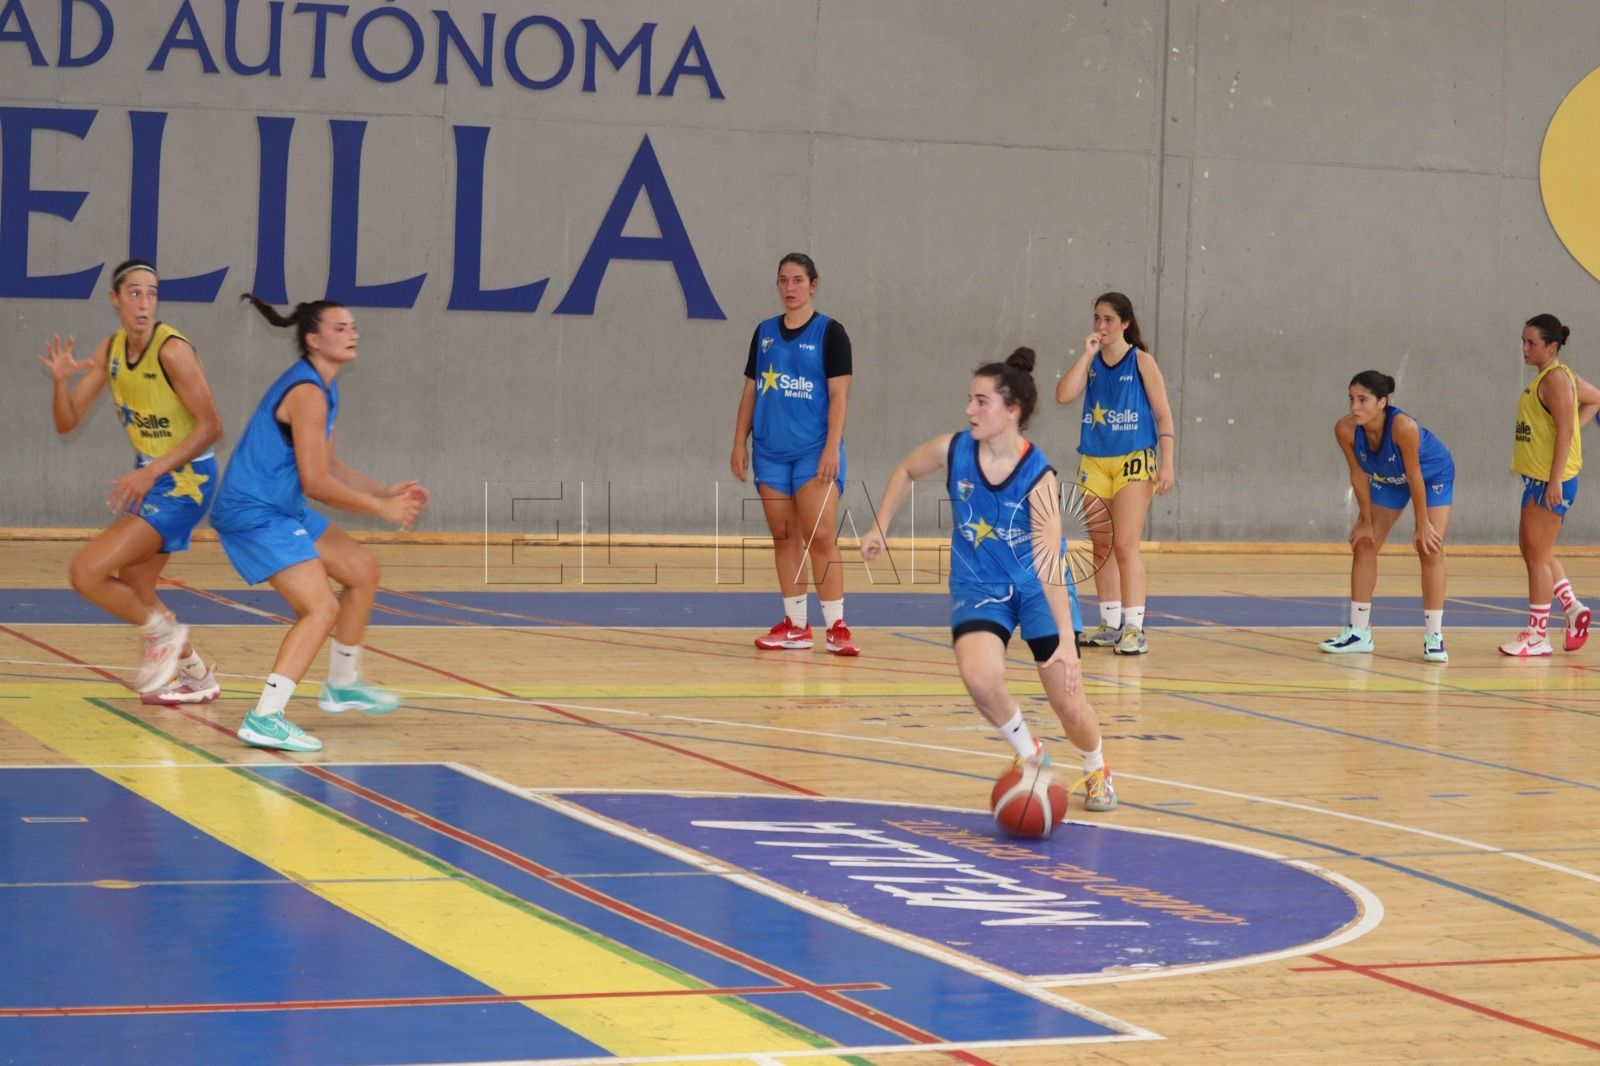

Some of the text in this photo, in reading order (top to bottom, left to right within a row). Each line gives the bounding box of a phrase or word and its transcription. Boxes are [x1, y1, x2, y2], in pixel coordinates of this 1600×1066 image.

[0, 0, 114, 67] AD
[0, 107, 728, 321] ELILLA
[780, 374, 814, 392] Salle
[134, 411, 170, 429] Salle
[1107, 409, 1139, 424] Salle
[1123, 458, 1141, 477] 10
